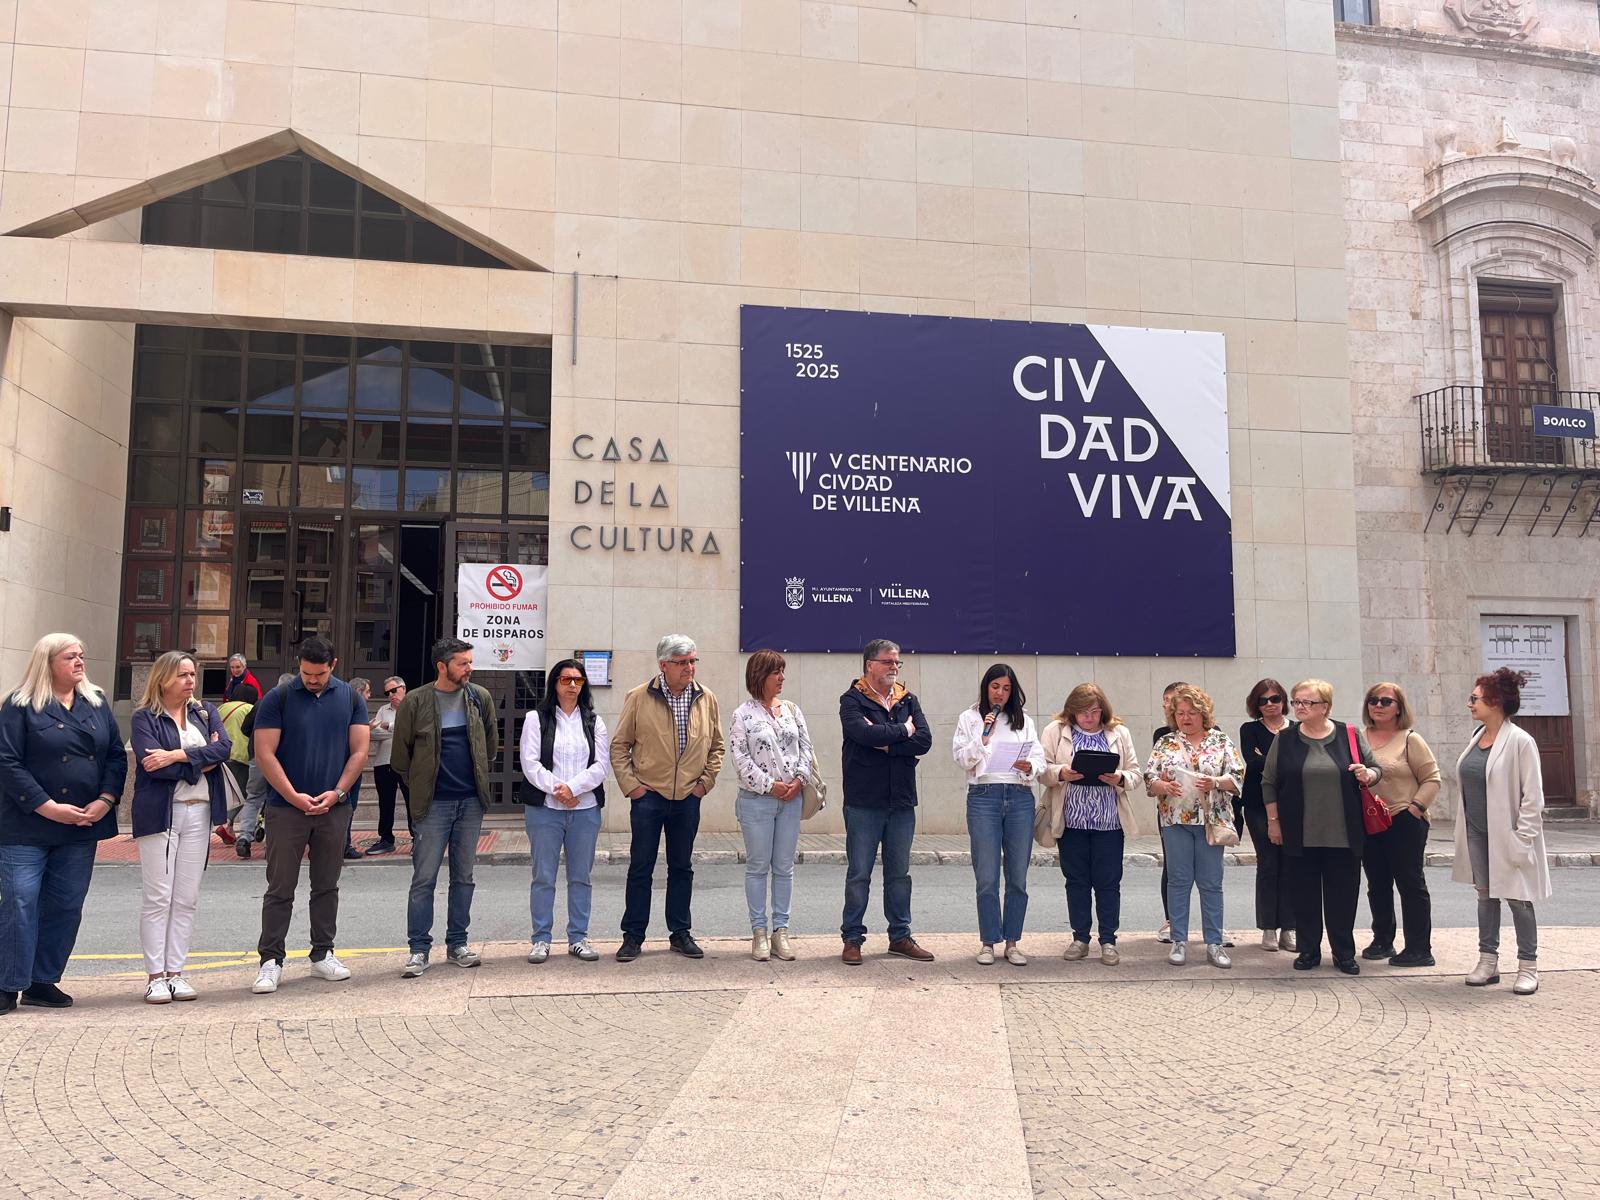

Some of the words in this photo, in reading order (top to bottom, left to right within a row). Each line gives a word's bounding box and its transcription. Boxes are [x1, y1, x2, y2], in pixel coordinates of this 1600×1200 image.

[785, 343, 823, 359] 1525
[796, 363, 839, 379] 2025
[1012, 355, 1106, 403] CIV
[1543, 416, 1587, 428] DOALCO
[1040, 413, 1159, 462] DAD
[572, 434, 669, 462] CASA
[829, 453, 843, 469] V
[848, 454, 972, 474] CENTENARIO
[819, 474, 893, 492] CIVDAD
[574, 480, 614, 505] DE
[630, 482, 669, 507] LA
[1067, 473, 1203, 521] VIVA
[812, 494, 837, 511] DE
[842, 495, 921, 513] VILLENA
[570, 525, 721, 554] CULTURA
[812, 594, 853, 602] VILLENA
[879, 588, 930, 599] VILLENA
[470, 602, 511, 610] PROHIBIDO
[512, 603, 538, 611] FUMAR
[486, 615, 521, 625] ZONA
[462, 628, 479, 638] DE
[483, 629, 544, 639] DISPAROS
